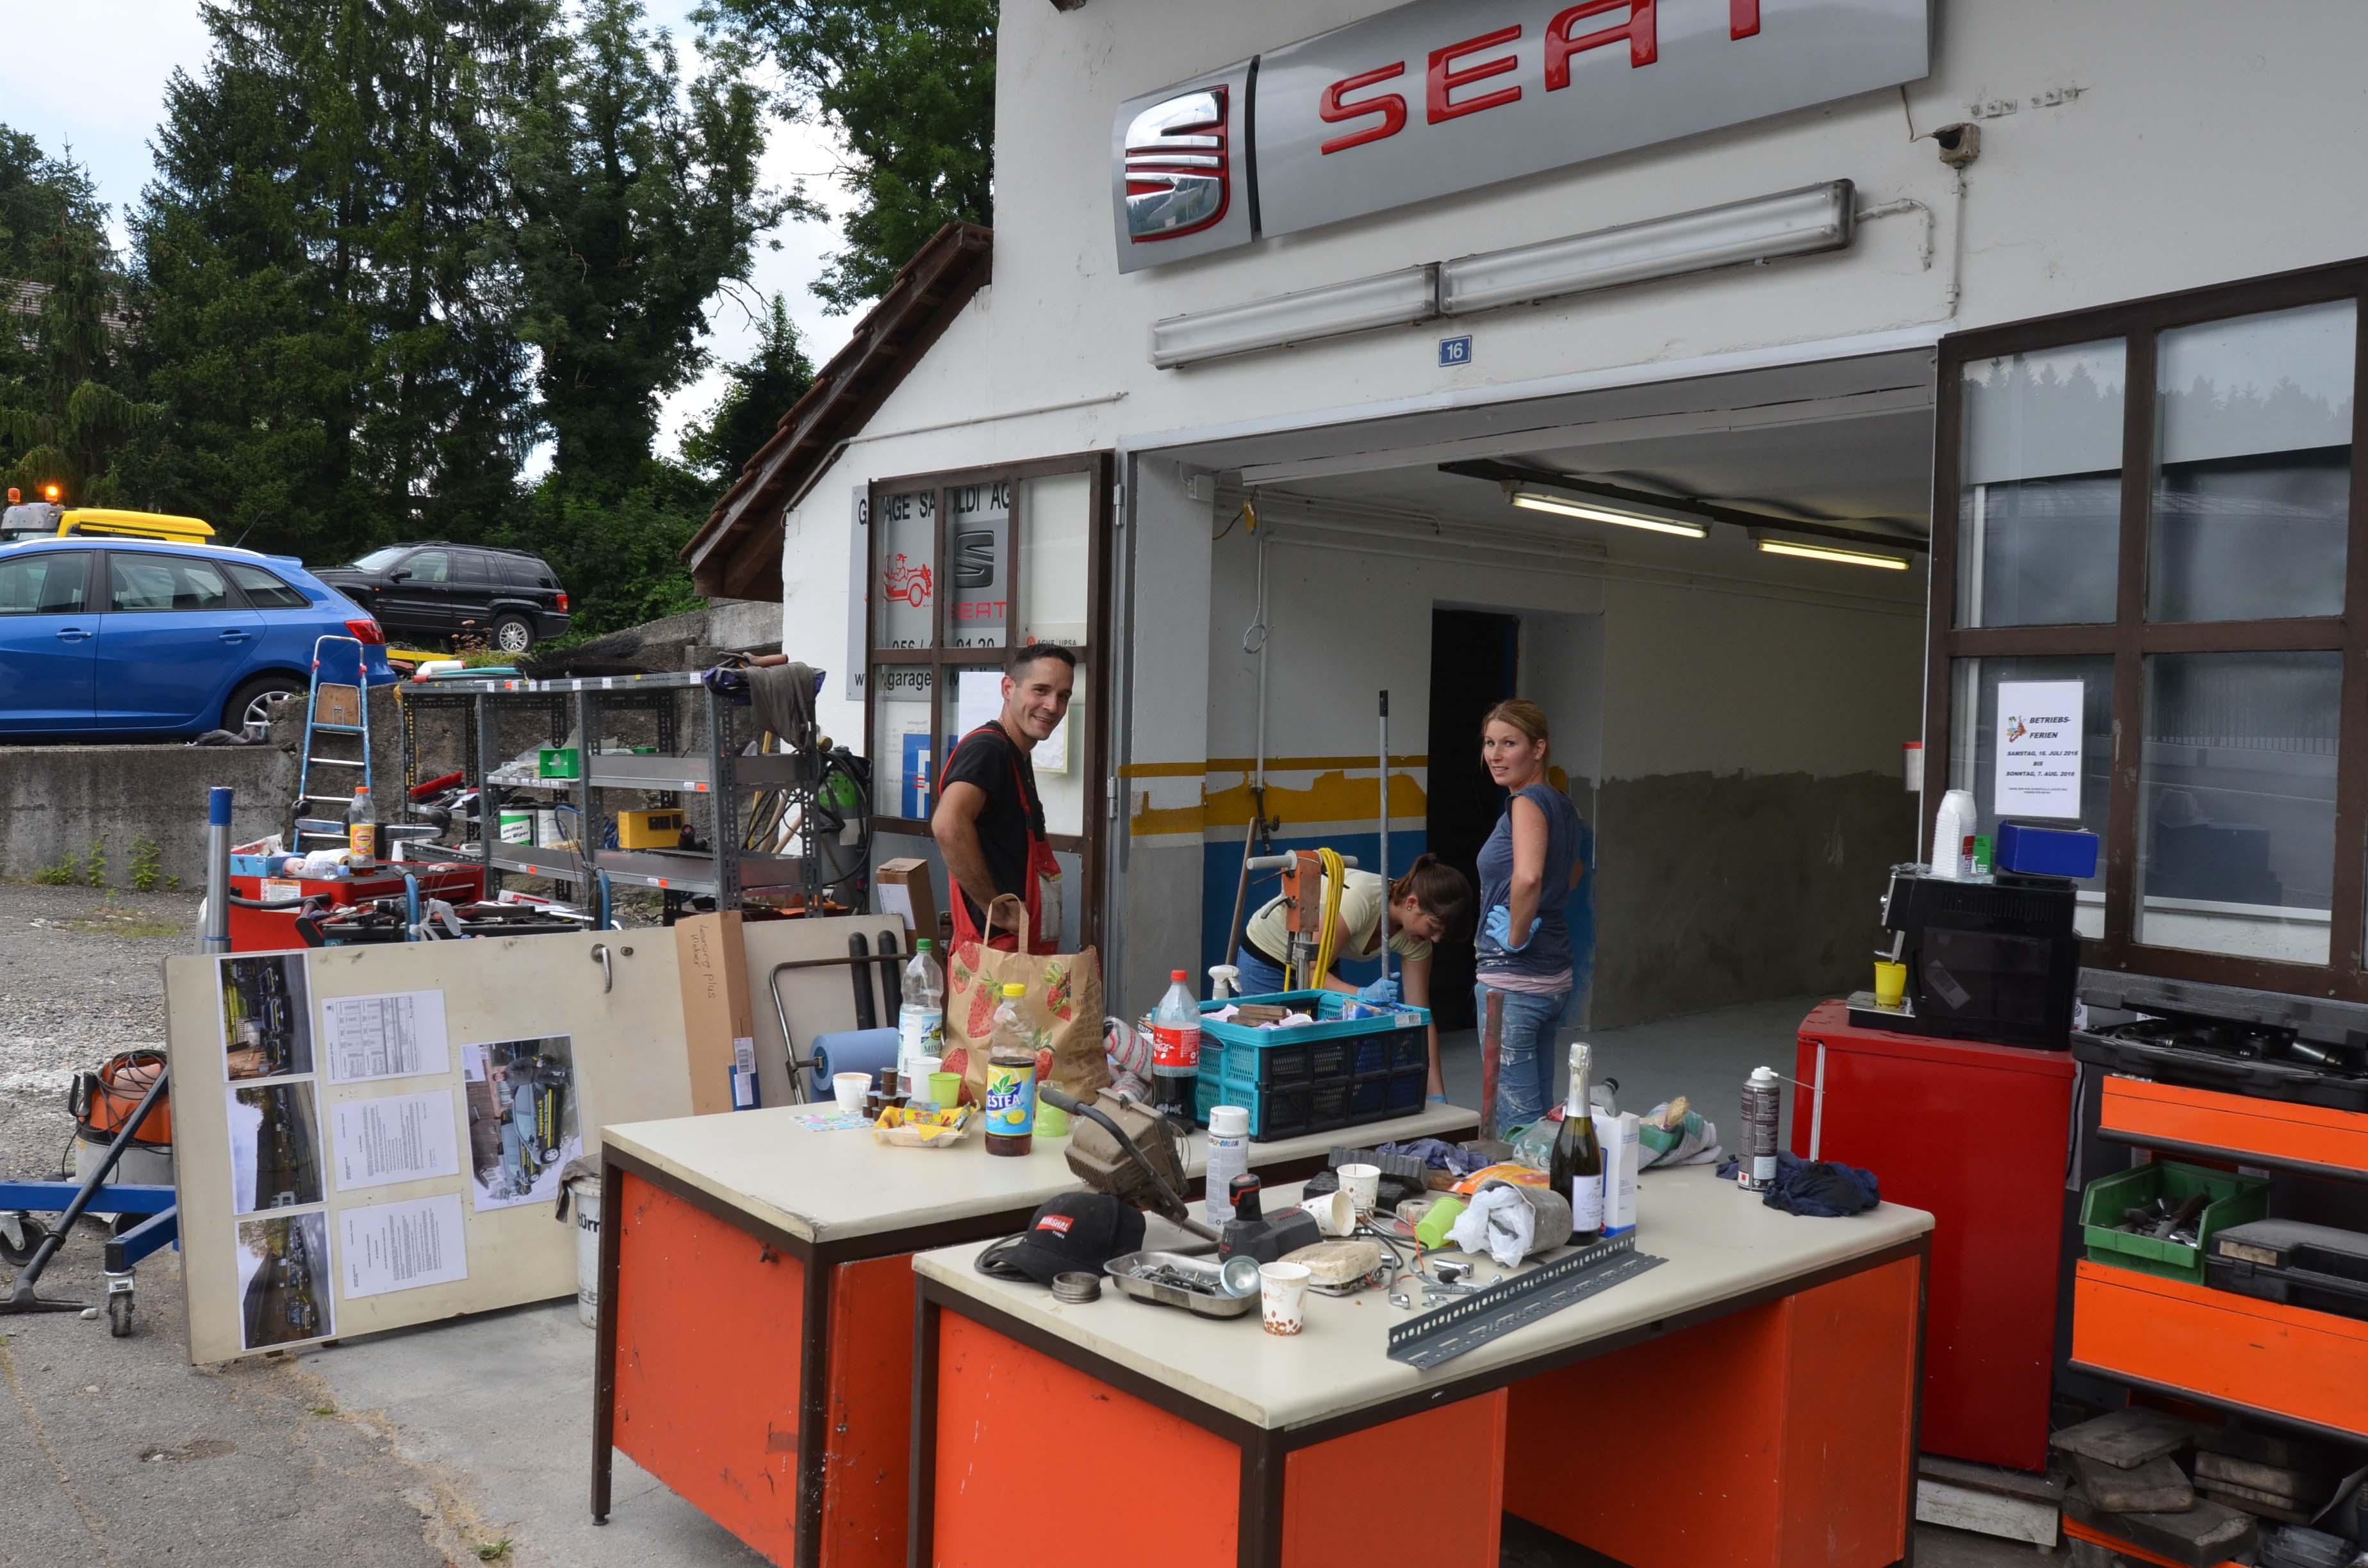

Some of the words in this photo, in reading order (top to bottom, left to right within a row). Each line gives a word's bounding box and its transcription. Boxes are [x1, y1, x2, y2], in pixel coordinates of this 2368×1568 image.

[1447, 342, 1463, 359] 16
[858, 494, 910, 525] GAGE
[990, 482, 1009, 510] AG
[703, 973, 718, 999] plus
